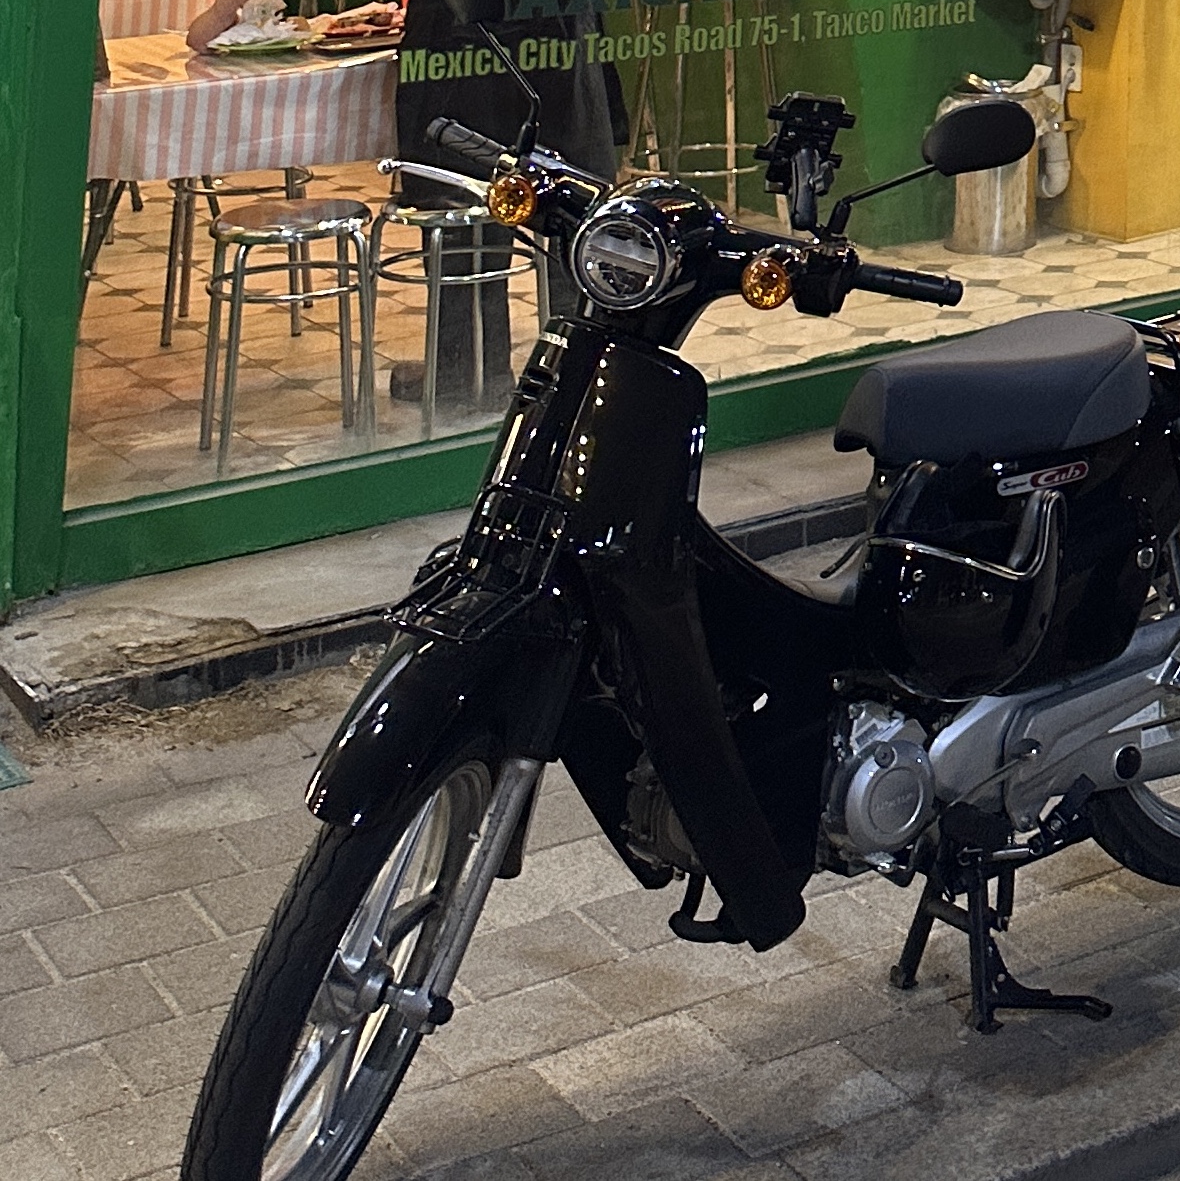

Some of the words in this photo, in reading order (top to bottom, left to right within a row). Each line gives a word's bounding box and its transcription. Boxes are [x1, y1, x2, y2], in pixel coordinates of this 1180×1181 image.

[518, 37, 577, 71] City
[584, 31, 667, 64] Tacos
[674, 19, 743, 55] Road
[812, 8, 884, 40] Taxco
[1037, 465, 1081, 485] Cub
